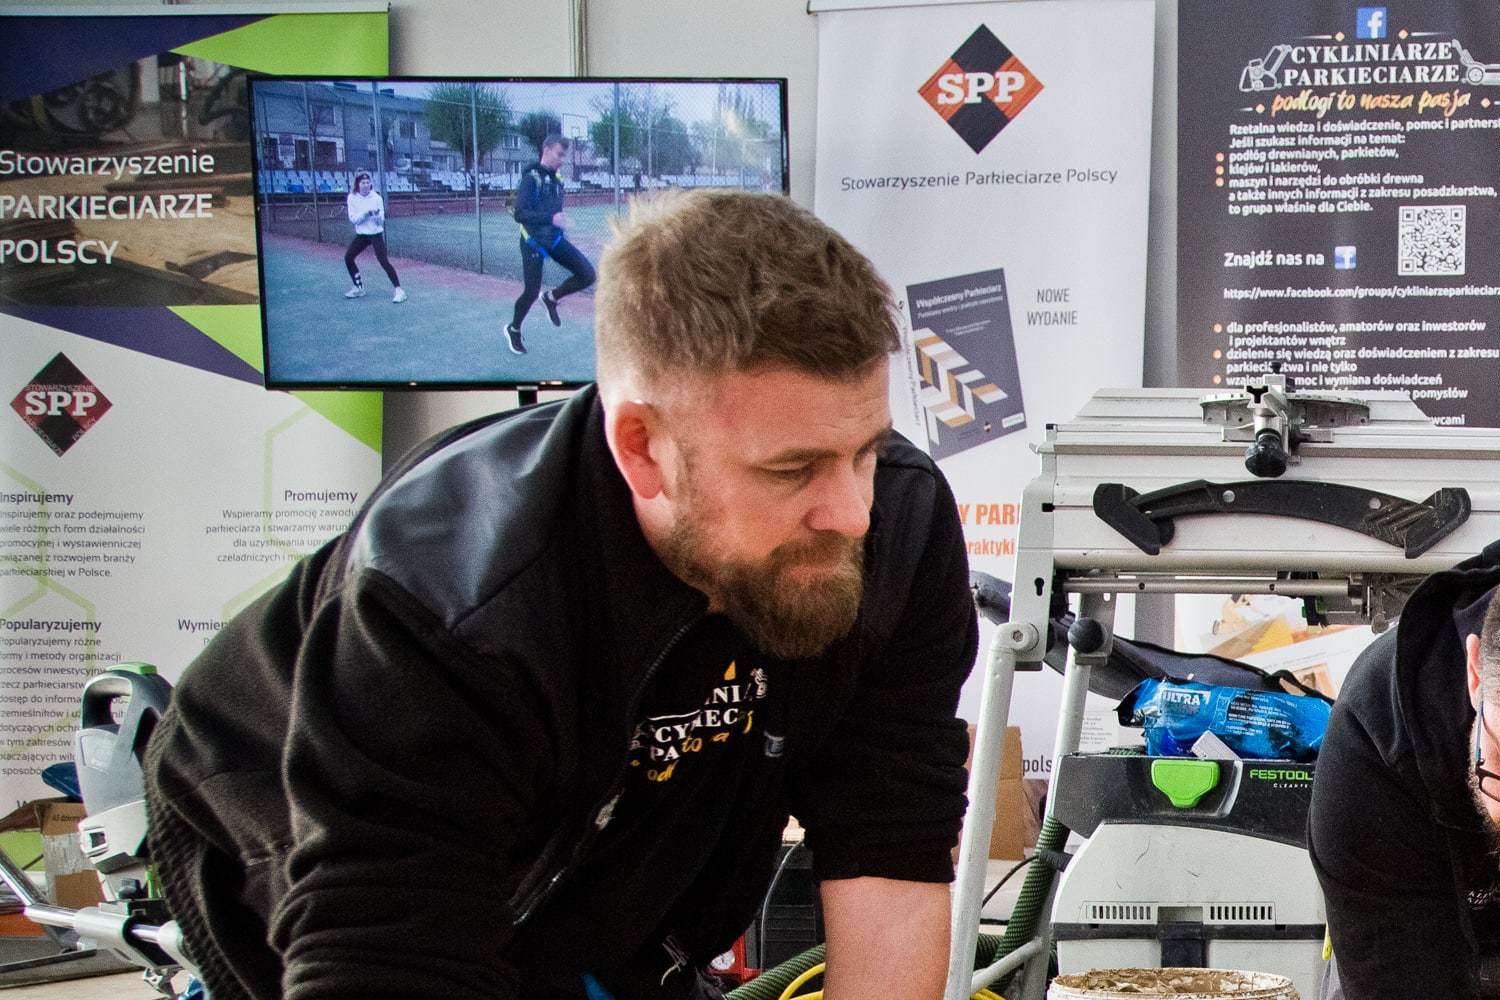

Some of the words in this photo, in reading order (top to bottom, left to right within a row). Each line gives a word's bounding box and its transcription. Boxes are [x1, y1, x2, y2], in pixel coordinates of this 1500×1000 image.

[1291, 43, 1452, 64] CYKLINIARZE
[1284, 64, 1459, 86] PARKIECIARZE
[937, 71, 1025, 105] SPP
[1271, 89, 1336, 118] podłogi
[1337, 89, 1355, 110] to
[1360, 93, 1414, 110] nasza
[1418, 89, 1471, 117] pasja
[1277, 121, 1314, 133] wiedza
[1317, 120, 1321, 132] i
[1323, 119, 1404, 133] doświadczenie,
[1406, 119, 1444, 132] pomoc
[1445, 118, 1449, 129] i
[1229, 137, 1254, 149] Jeśli
[1255, 135, 1296, 147] szukasz
[1298, 134, 1352, 147] informacji
[1353, 134, 1367, 145] na
[1369, 133, 1406, 144] temat:
[1229, 149, 1266, 163] podłóg
[1268, 147, 1339, 161] drewnianych,
[1341, 146, 1399, 160] parkietów,
[0, 149, 215, 181] Stowarzyszenie
[1229, 163, 1263, 176] klejów
[1265, 162, 1269, 173] i
[1271, 160, 1321, 174] lakierów,
[841, 171, 960, 192] Stowarzyszenie
[965, 169, 1062, 187] Parkieciarze
[1066, 167, 1118, 185] Polscy
[1229, 177, 1267, 190] maszyn
[1269, 176, 1273, 187] i
[1275, 175, 1321, 188] narzędzi
[1323, 175, 1337, 186] do
[1339, 172, 1381, 185] obróbki
[1382, 172, 1424, 184] drewna
[0, 193, 213, 220] PARKIECIARZE
[1229, 204, 1241, 215] to
[1242, 203, 1273, 217] grupa
[1274, 201, 1316, 214] właśnie
[1318, 201, 1335, 213] dla
[1337, 200, 1373, 212] Ciebie.
[0, 239, 119, 265] POLSCY
[1224, 249, 1273, 269] Znajdź
[1276, 253, 1302, 266] nas
[1306, 253, 1325, 266] na
[1036, 288, 1070, 303] NOWE
[1027, 311, 1078, 326] WYDANIE
[1227, 322, 1243, 333] dla
[1245, 321, 1338, 335] profesjonalistów,
[1339, 320, 1394, 332] amatorów
[1396, 321, 1420, 332] oraz
[1421, 319, 1486, 332] inwestorów
[1229, 335, 1233, 346] i
[1234, 334, 1307, 348] projektantów
[1309, 335, 1346, 348] wnętrz
[1226, 348, 1274, 359] dzielenie
[1276, 347, 1292, 361] się
[1294, 347, 1331, 361] wiedzą
[1333, 348, 1357, 359] oraz
[1358, 347, 1447, 359] doświadczeniem
[1449, 349, 1455, 358] z
[1457, 346, 1500, 358] zakresu
[25, 390, 98, 416] SPP
[284, 489, 358, 504] Promujemy
[222, 508, 273, 520] Wspieramy
[275, 508, 318, 519] promocję
[0, 618, 102, 633] Popularyzujemy
[1162, 692, 1200, 706] ULTRA
[1249, 768, 1314, 781] FESTOOL
